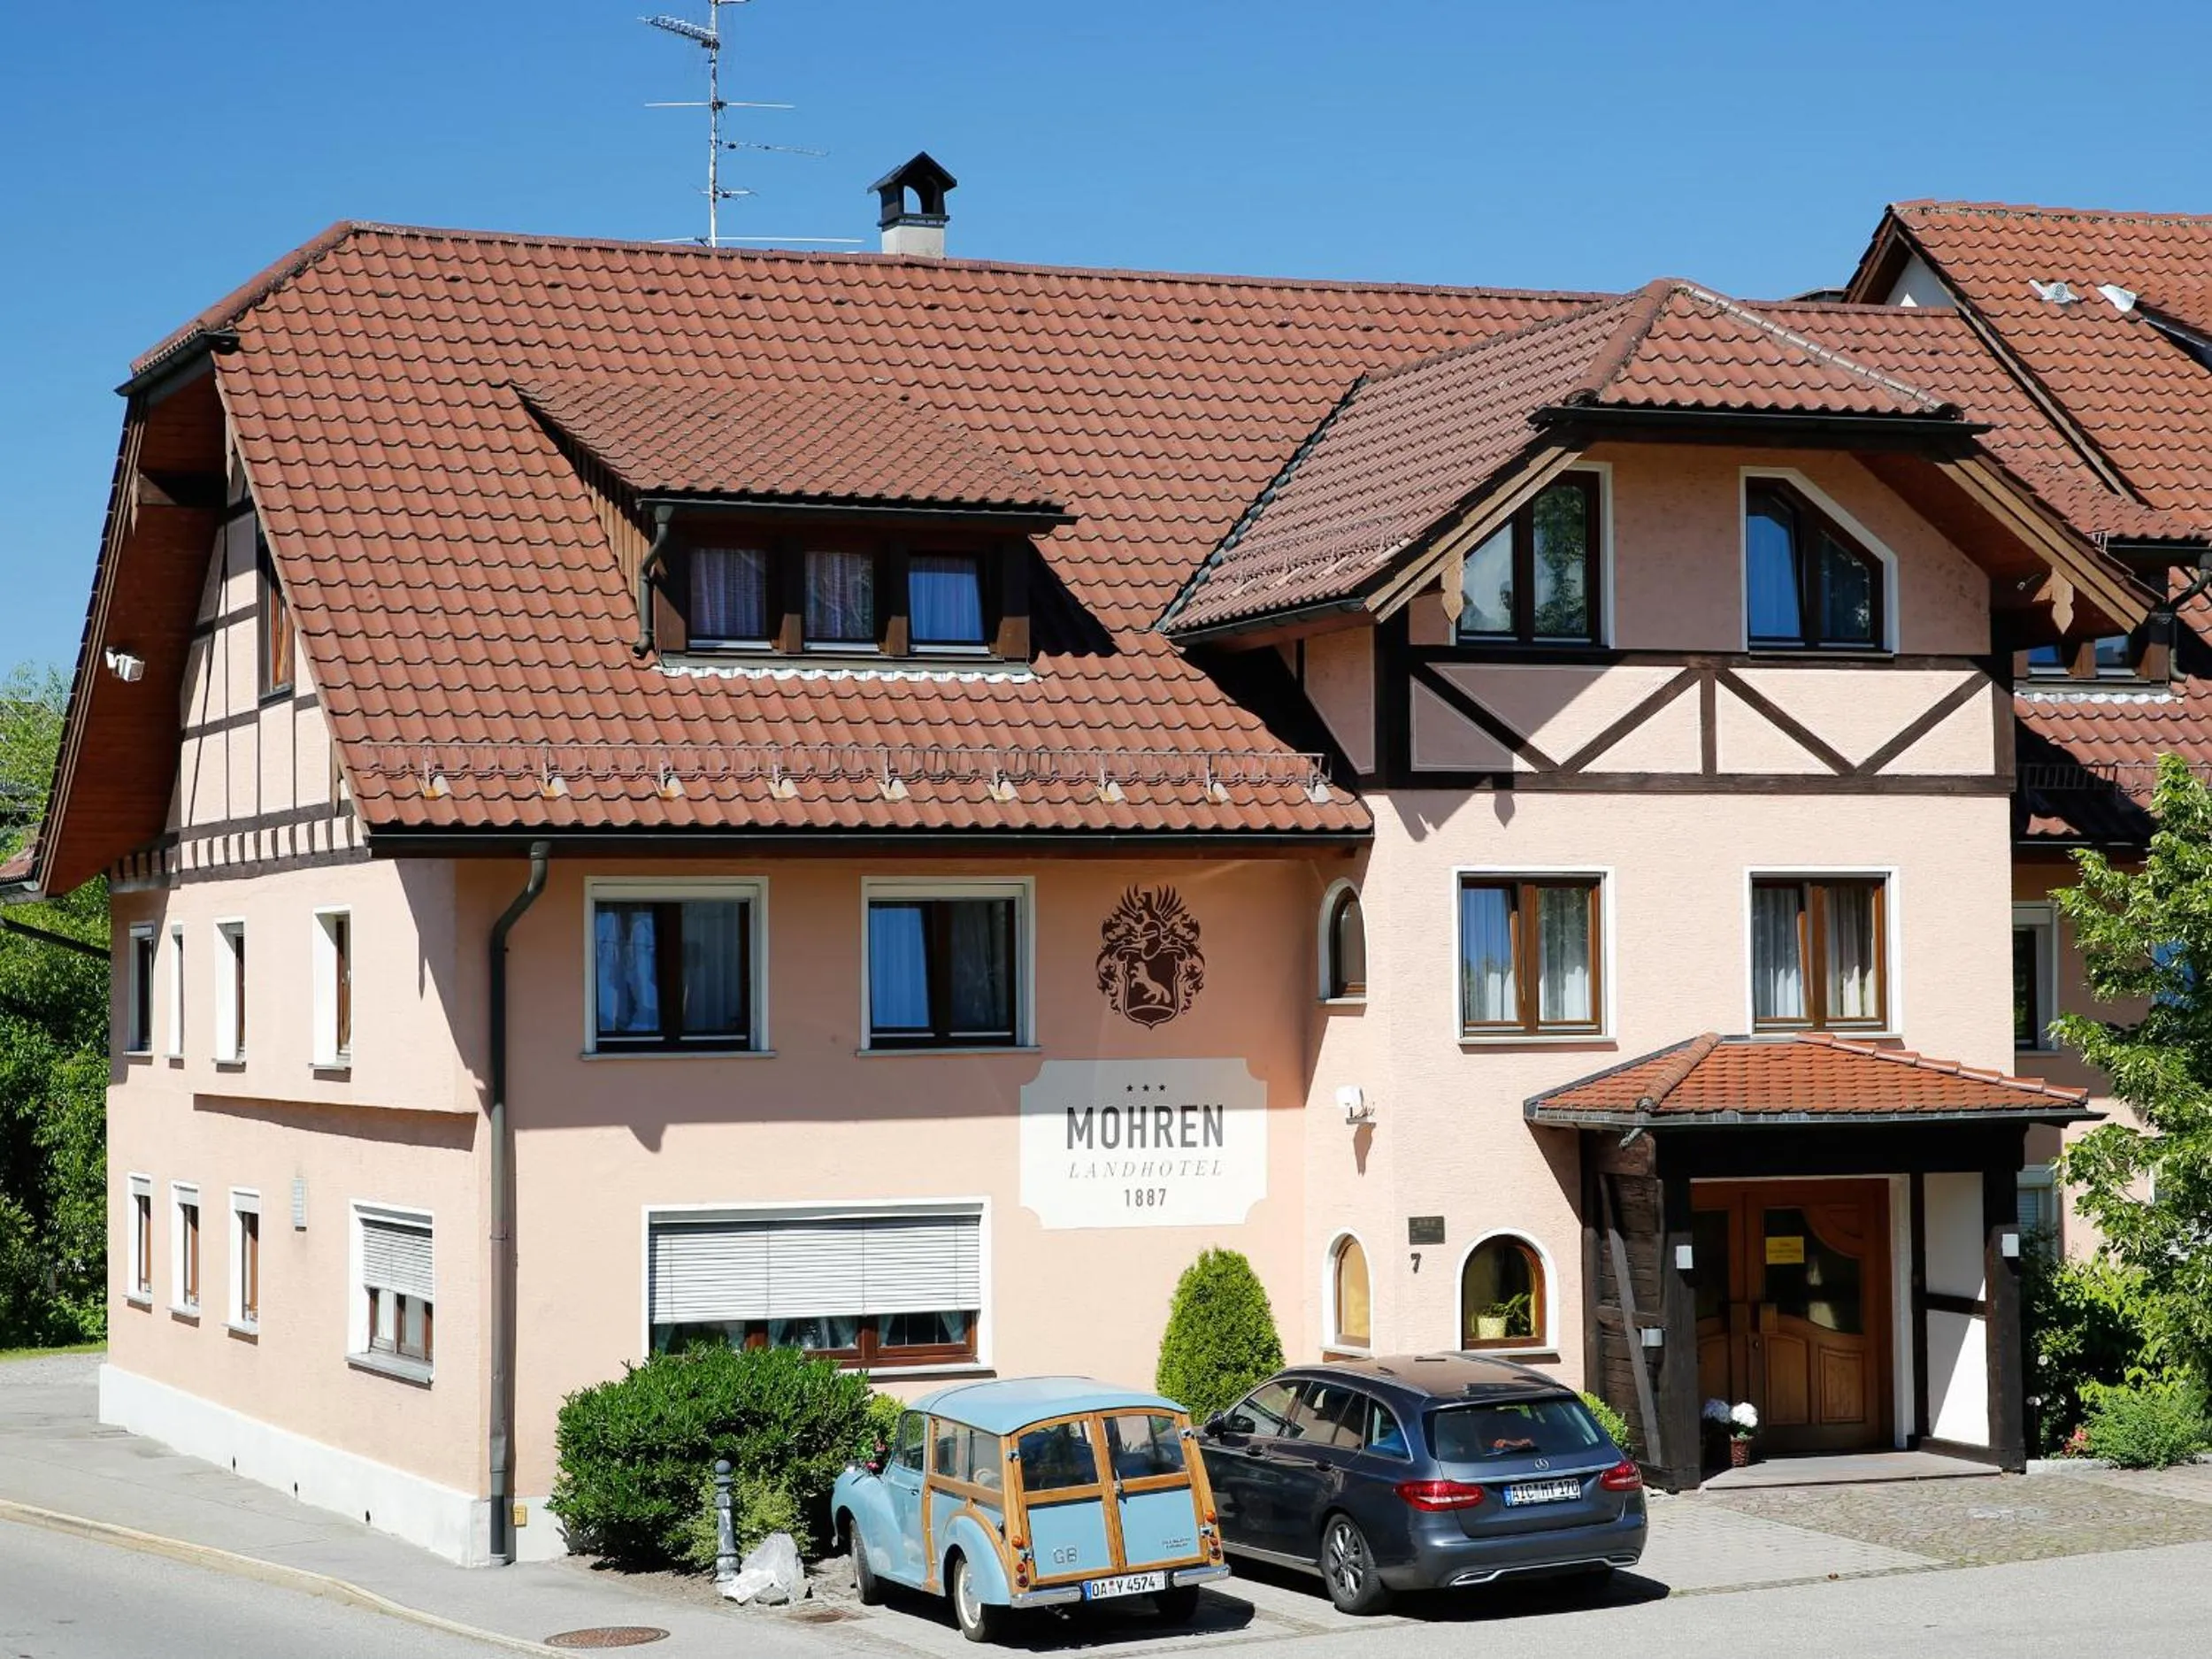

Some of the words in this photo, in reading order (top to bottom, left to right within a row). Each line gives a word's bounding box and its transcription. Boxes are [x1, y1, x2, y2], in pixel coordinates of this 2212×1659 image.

[1066, 1104, 1224, 1150] MOHREN
[1067, 1159, 1223, 1179] LANDHOTEL
[1125, 1187, 1167, 1208] 1887
[1409, 1252, 1422, 1274] 7
[1053, 1548, 1078, 1564] GB
[1126, 1576, 1156, 1592] 4574
